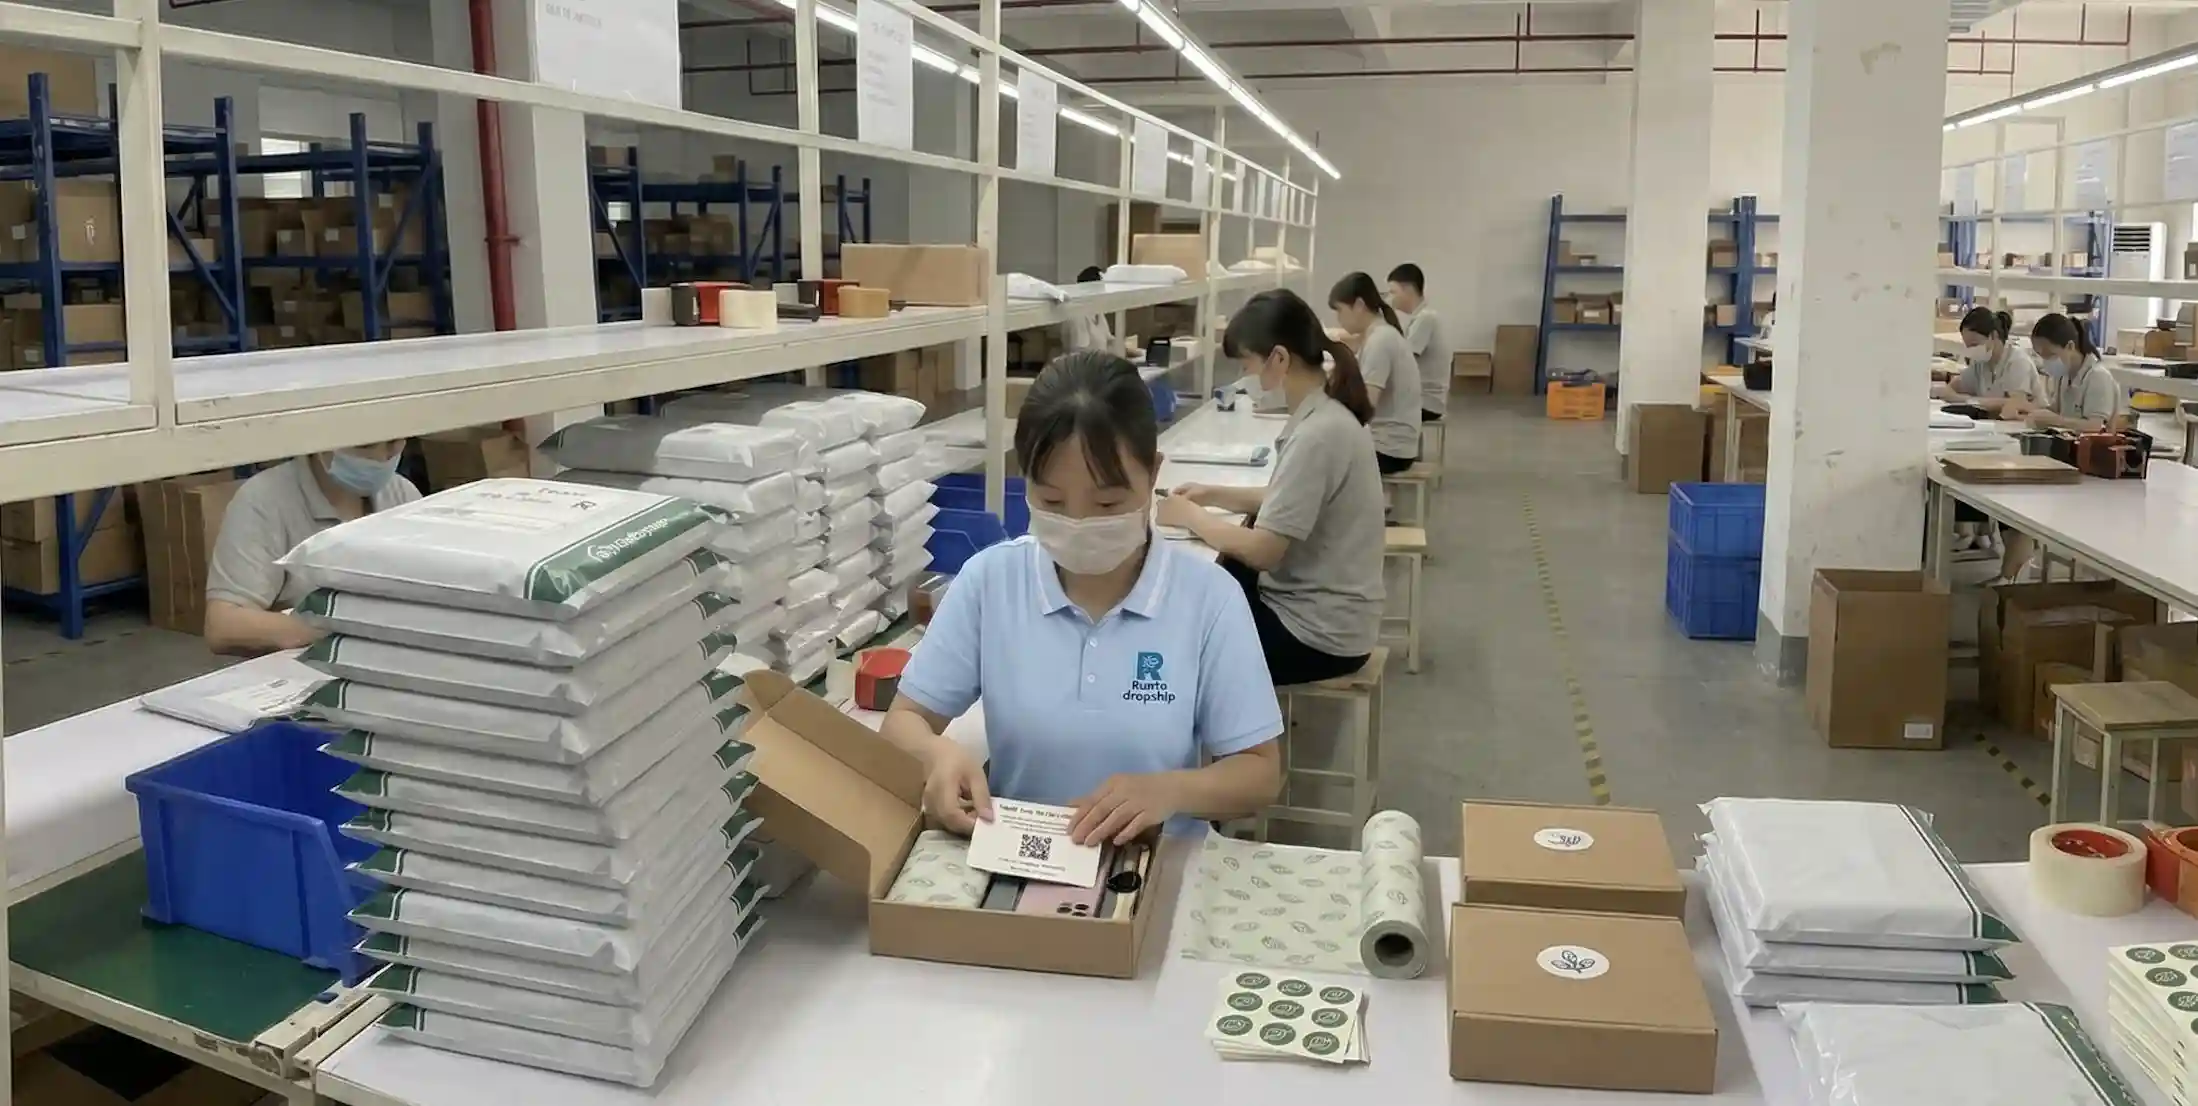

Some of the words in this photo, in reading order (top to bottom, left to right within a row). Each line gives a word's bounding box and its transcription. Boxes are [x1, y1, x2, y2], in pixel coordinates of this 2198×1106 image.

[1136, 652, 1163, 680] R
[1131, 681, 1167, 690] Runto
[1122, 690, 1175, 704] dropship
